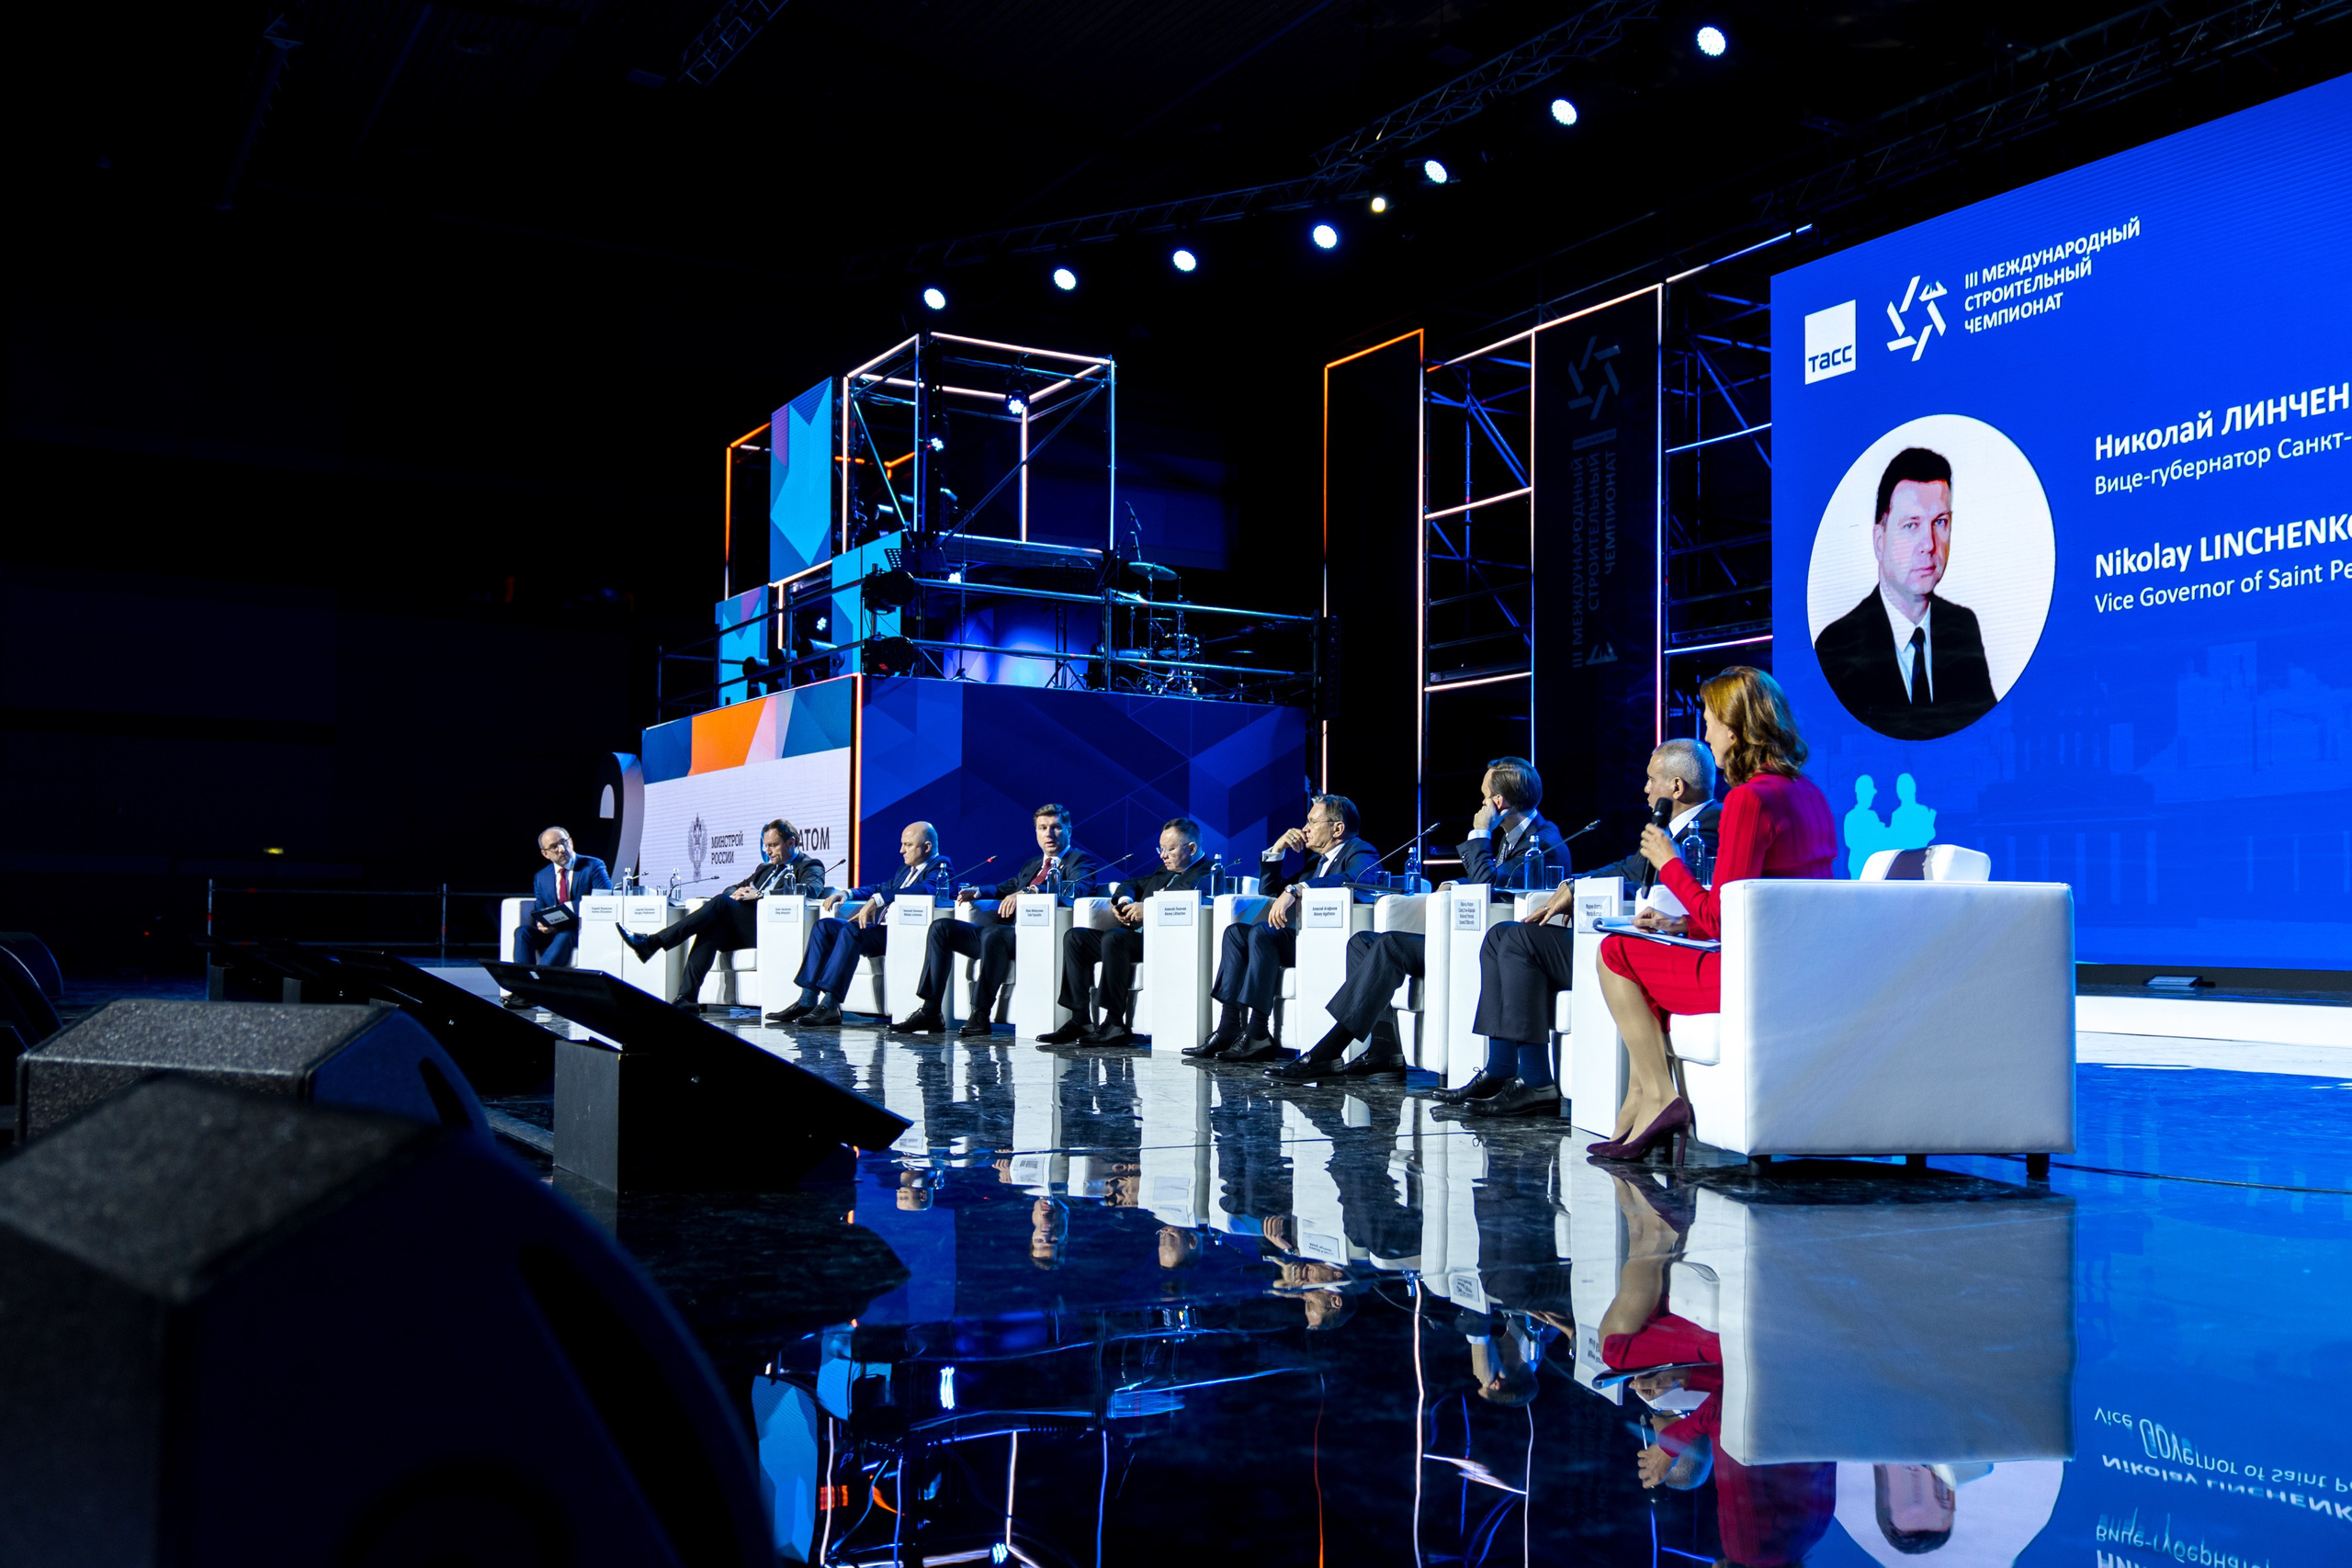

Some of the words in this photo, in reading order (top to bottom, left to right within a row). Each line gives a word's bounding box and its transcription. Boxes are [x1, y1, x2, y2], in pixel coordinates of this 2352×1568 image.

[1982, 216, 2141, 284] МЕЖДУНАРОДНЫЙ
[1964, 255, 2092, 311] СТРОИТЕЛЬНЫЙ
[1964, 292, 2064, 333] ЧЕМПИОНАТ
[2095, 410, 2213, 460] Николай
[2221, 382, 2350, 435] ЛИНЧЕН
[2095, 446, 2271, 495] Вице-губернатор
[2278, 432, 2352, 459] Санкт-
[1586, 452, 1600, 612] СТРОИТЕЛЬНЫЙ
[1603, 449, 1617, 576] ЧЕМПИОНАТ
[1569, 457, 1586, 647] МЕЖДУНАРОДНЫЙ
[2095, 542, 2192, 579] Nikolay
[2200, 513, 2352, 562] LINCHENK
[2095, 592, 2134, 613] Vice
[2140, 580, 2235, 607] Governor
[2240, 570, 2264, 593] of
[2268, 564, 2324, 590] Saint
[711, 830, 744, 849] МИНСТРОЙ
[711, 851, 734, 864] РОССИИ
[797, 827, 831, 852] АТОМ
